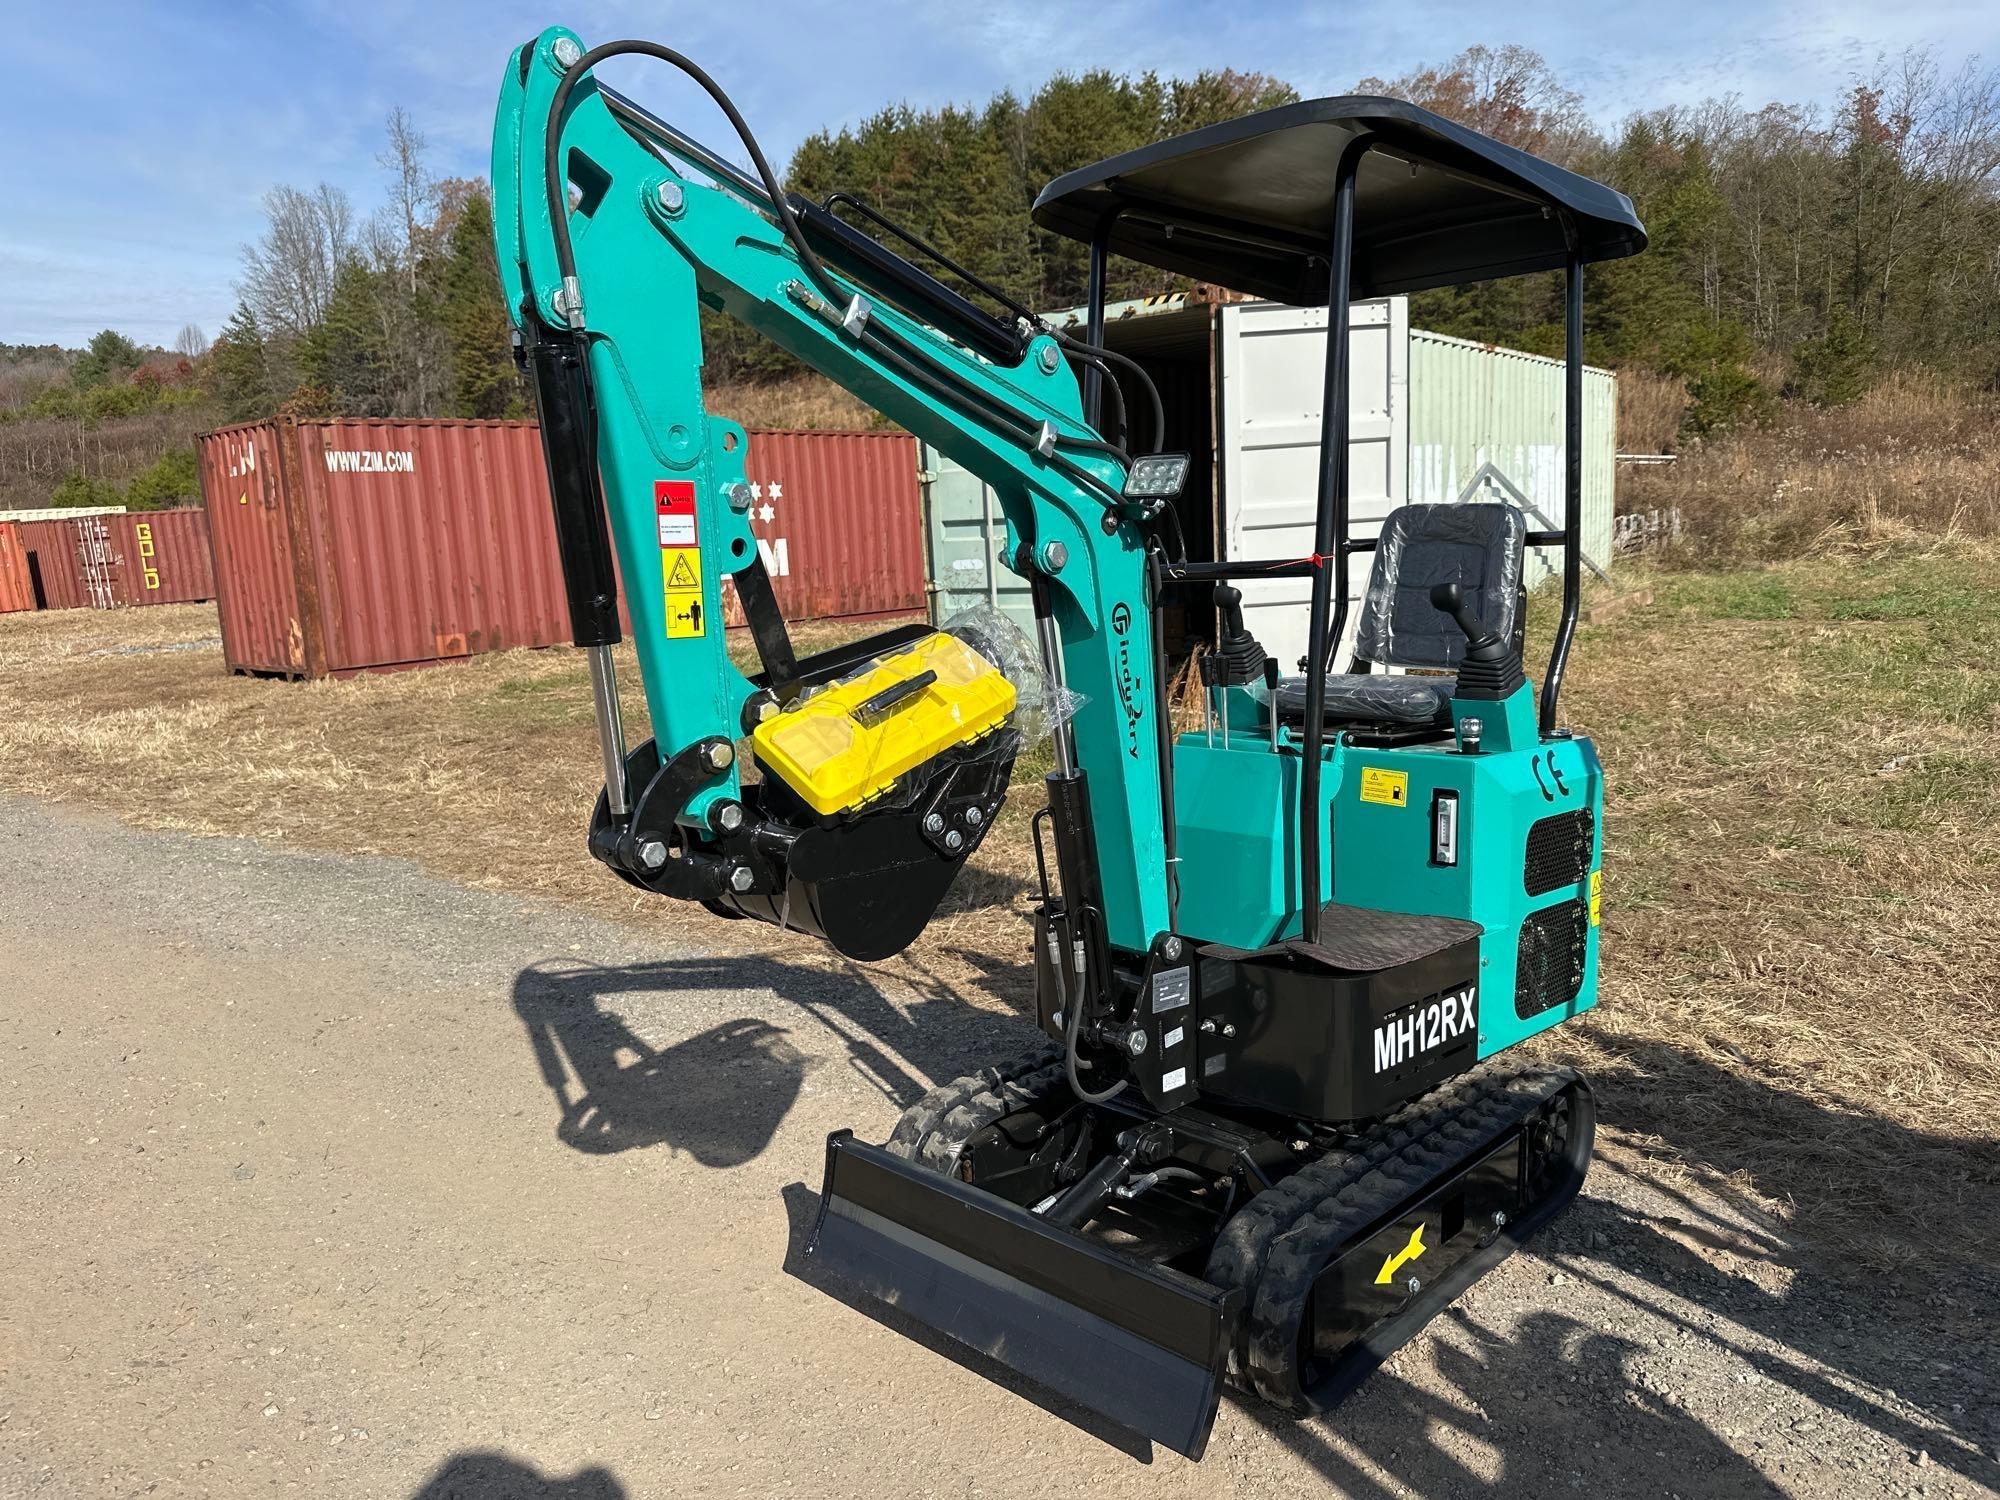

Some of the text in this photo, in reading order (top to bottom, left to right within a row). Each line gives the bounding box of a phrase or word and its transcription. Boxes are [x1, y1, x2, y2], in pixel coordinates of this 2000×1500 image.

[325, 451, 414, 473] WWW.ZIM.COM
[136, 523, 160, 590] GOLD
[1532, 749, 1569, 802] CE
[1374, 986, 1476, 1074] MH12RX
